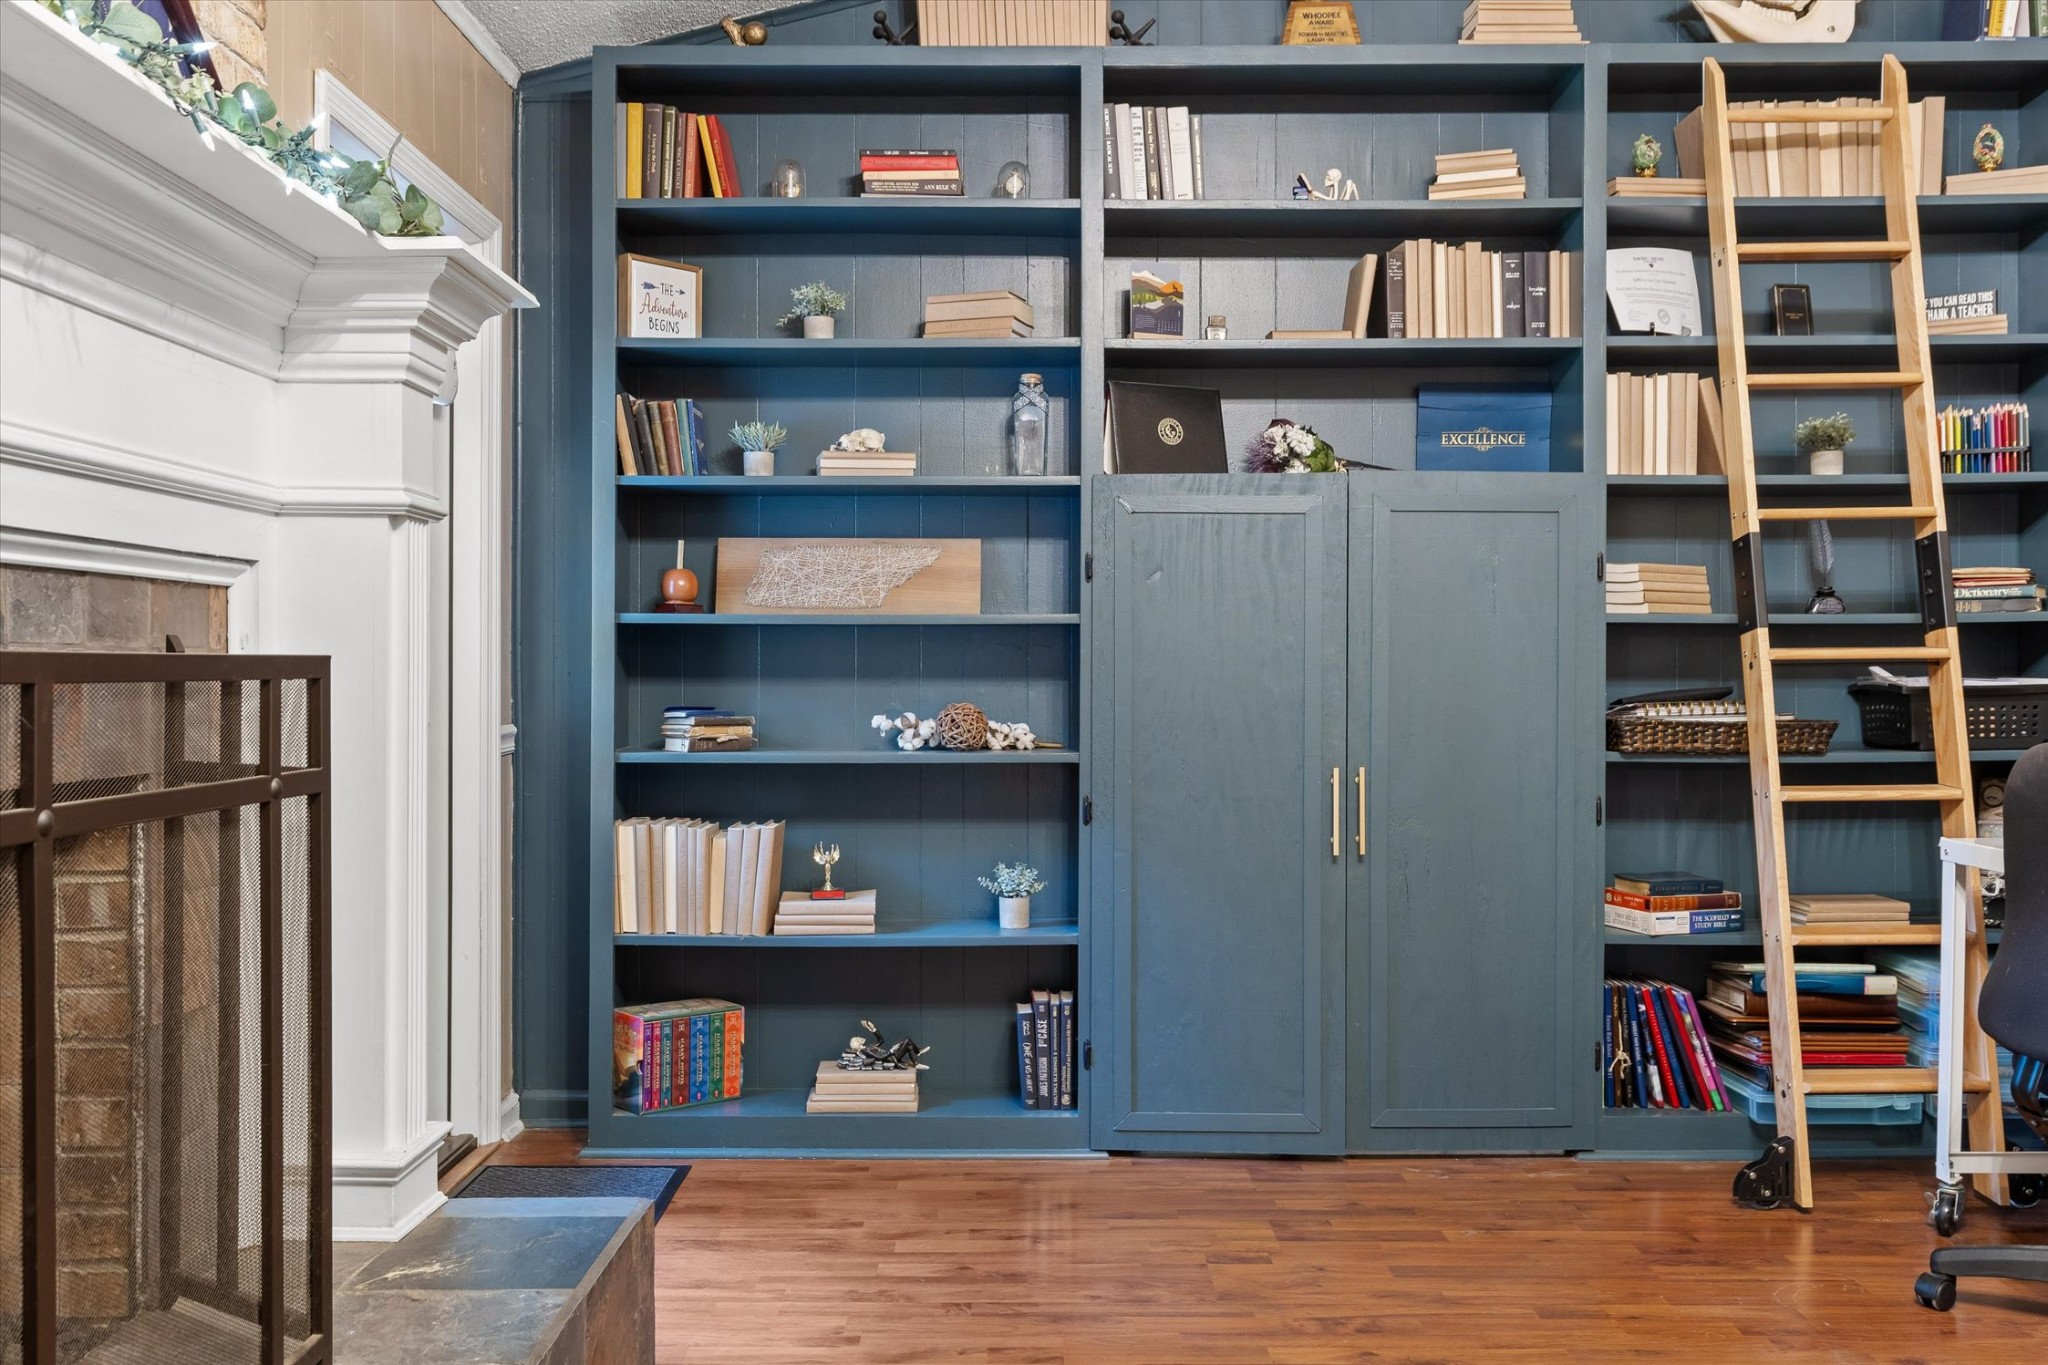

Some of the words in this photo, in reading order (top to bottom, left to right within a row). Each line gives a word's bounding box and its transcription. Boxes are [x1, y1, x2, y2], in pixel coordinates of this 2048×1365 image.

[1302, 11, 1342, 20] WHOOPEE
[660, 282, 674, 297] THE
[639, 292, 688, 320] Adventure
[1929, 297, 1944, 308] YOU
[1943, 294, 1958, 307] CAN
[1959, 293, 1977, 305] READ
[1977, 290, 1994, 303] THIS
[1950, 306, 1957, 319] A
[1957, 302, 1994, 319] TEACHER
[648, 316, 680, 335] BEGINS
[1441, 433, 1526, 445] EXCELLENCE
[1954, 586, 2010, 599] Dictionary
[1704, 914, 1730, 922] SCOFIELD
[1037, 1019, 1048, 1039] CASE
[1022, 1042, 1033, 1060] ONE
[1025, 1065, 1033, 1074] US
[1039, 1057, 1048, 1081] PATTERSON
[1039, 1081, 1049, 1097] JAMES
